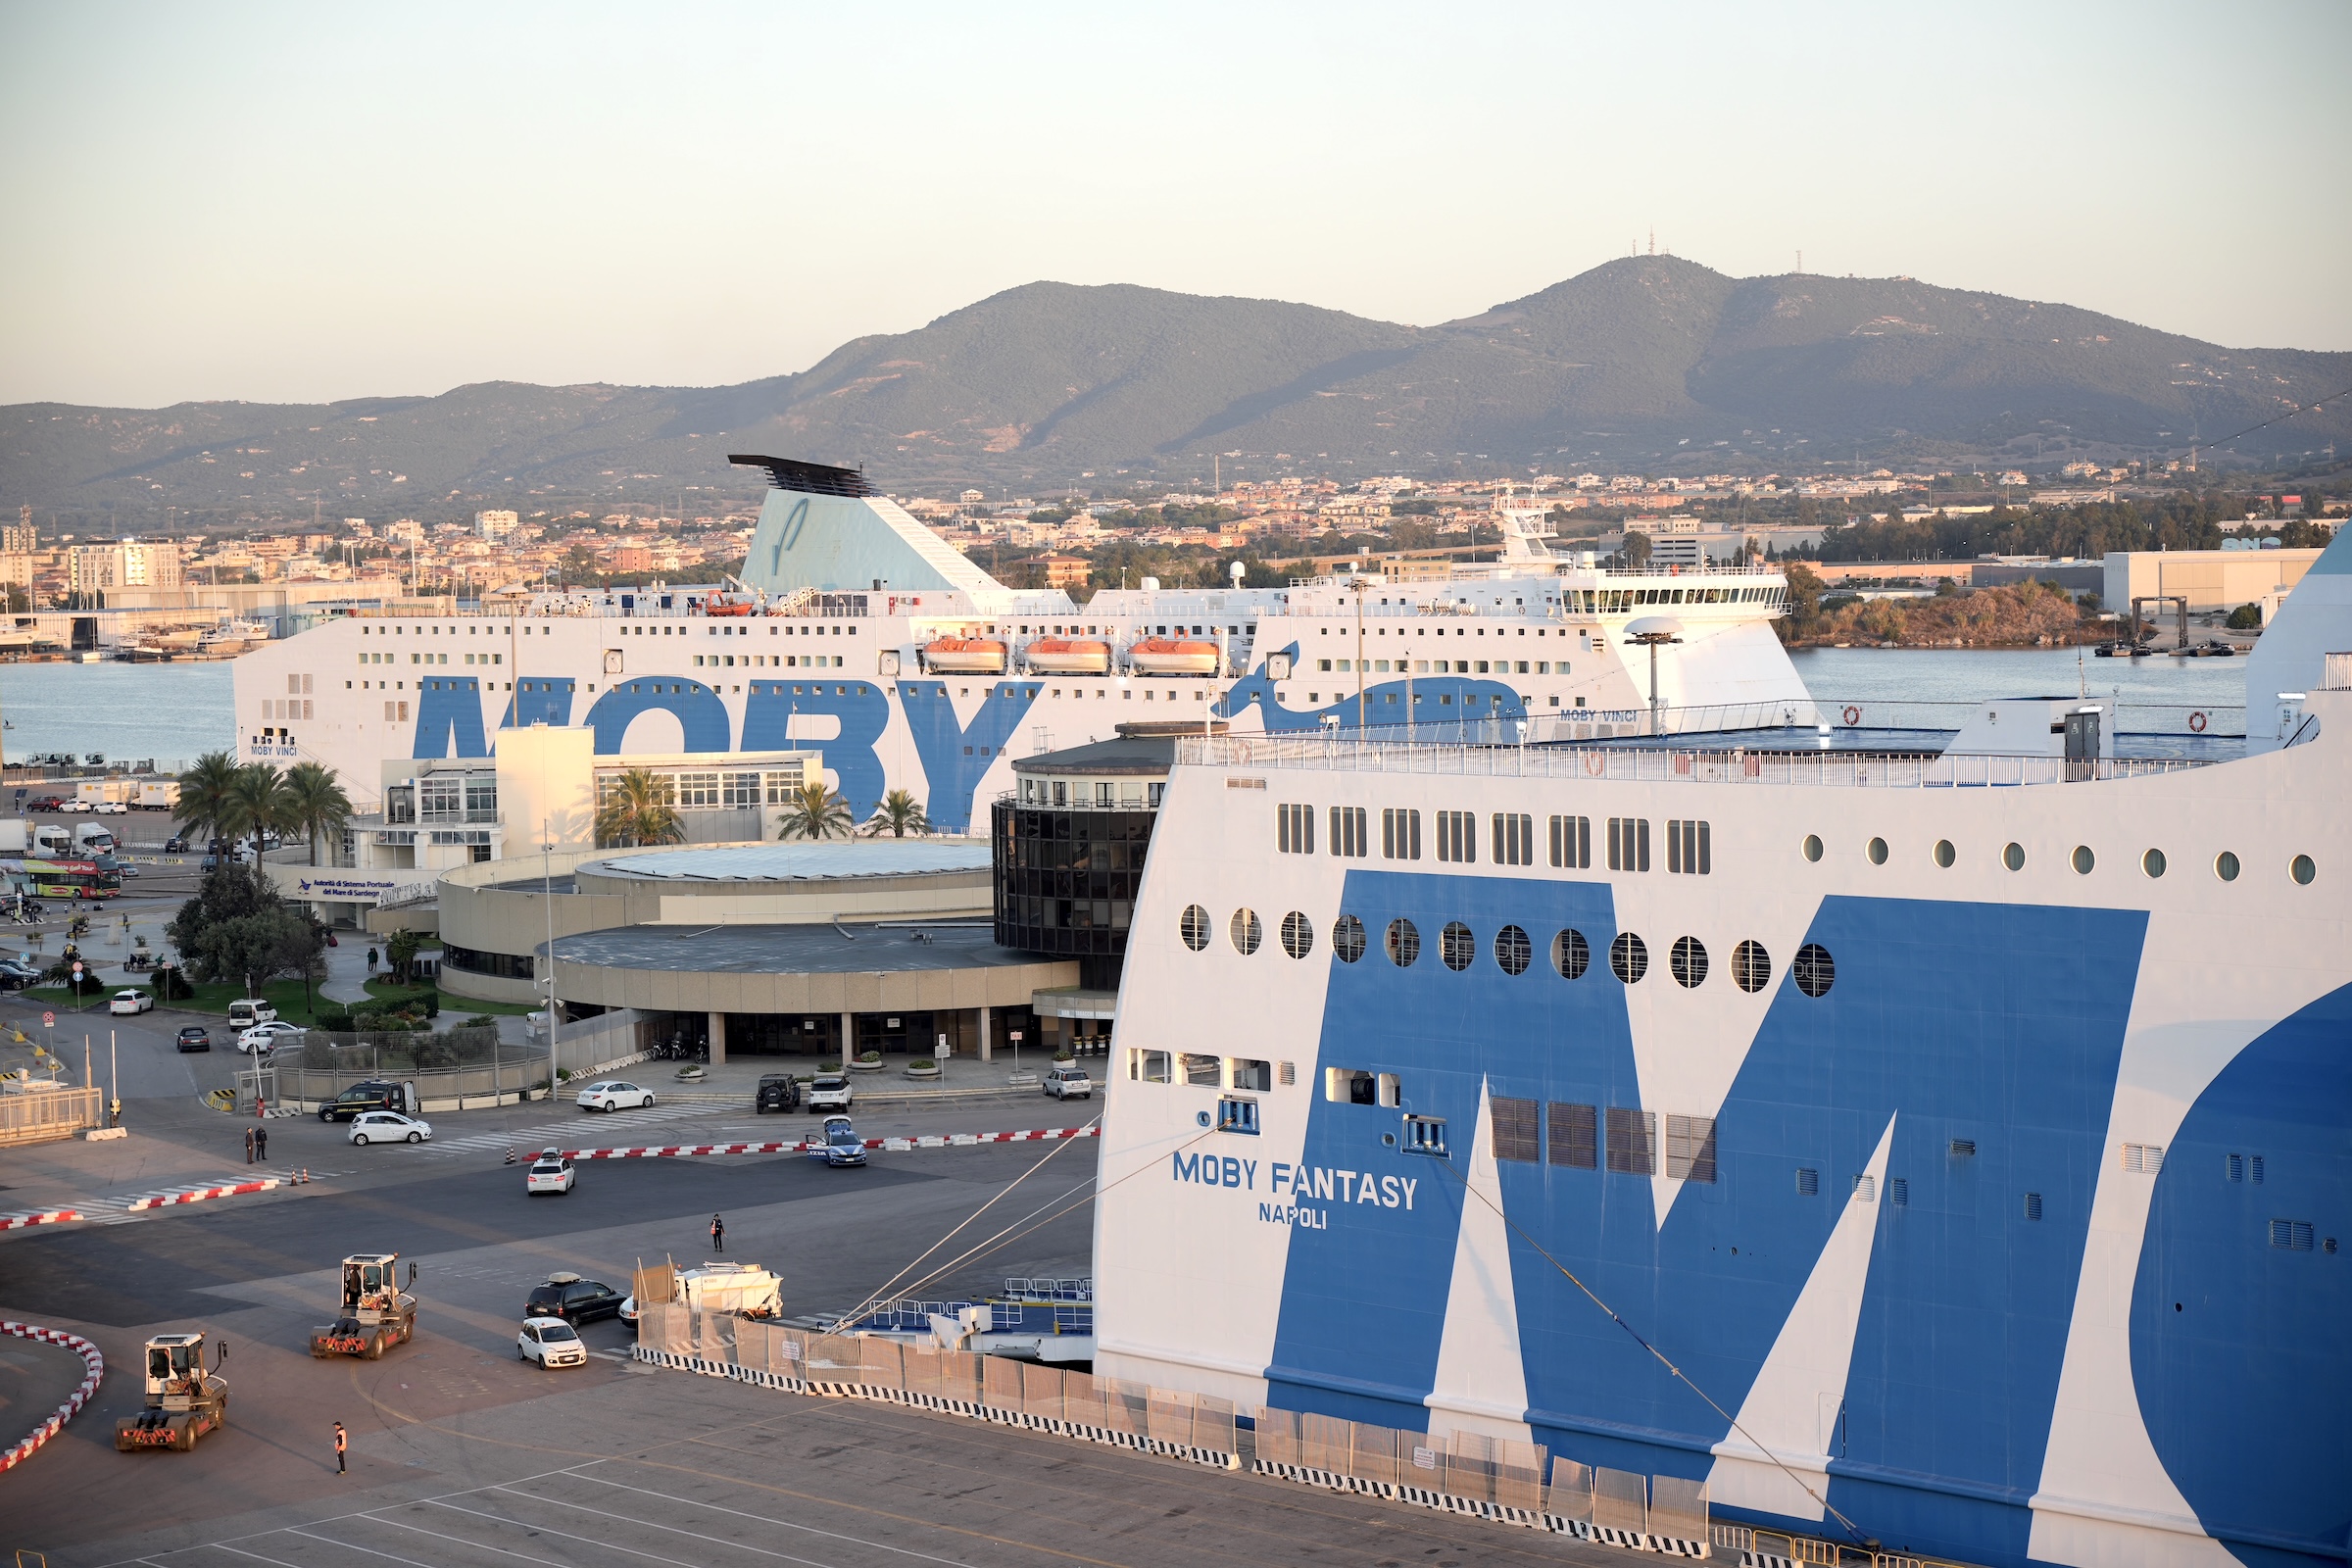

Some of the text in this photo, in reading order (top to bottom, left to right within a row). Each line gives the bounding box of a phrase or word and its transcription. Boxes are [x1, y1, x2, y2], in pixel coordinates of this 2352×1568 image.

[1560, 710, 1638, 722] MOBY VINCI
[251, 746, 297, 757] MOBY VINCI
[354, 889, 380, 898] Sardegn
[1173, 1151, 1418, 1211] MOBY FANTASY
[1259, 1201, 1328, 1231] NAPOLI
